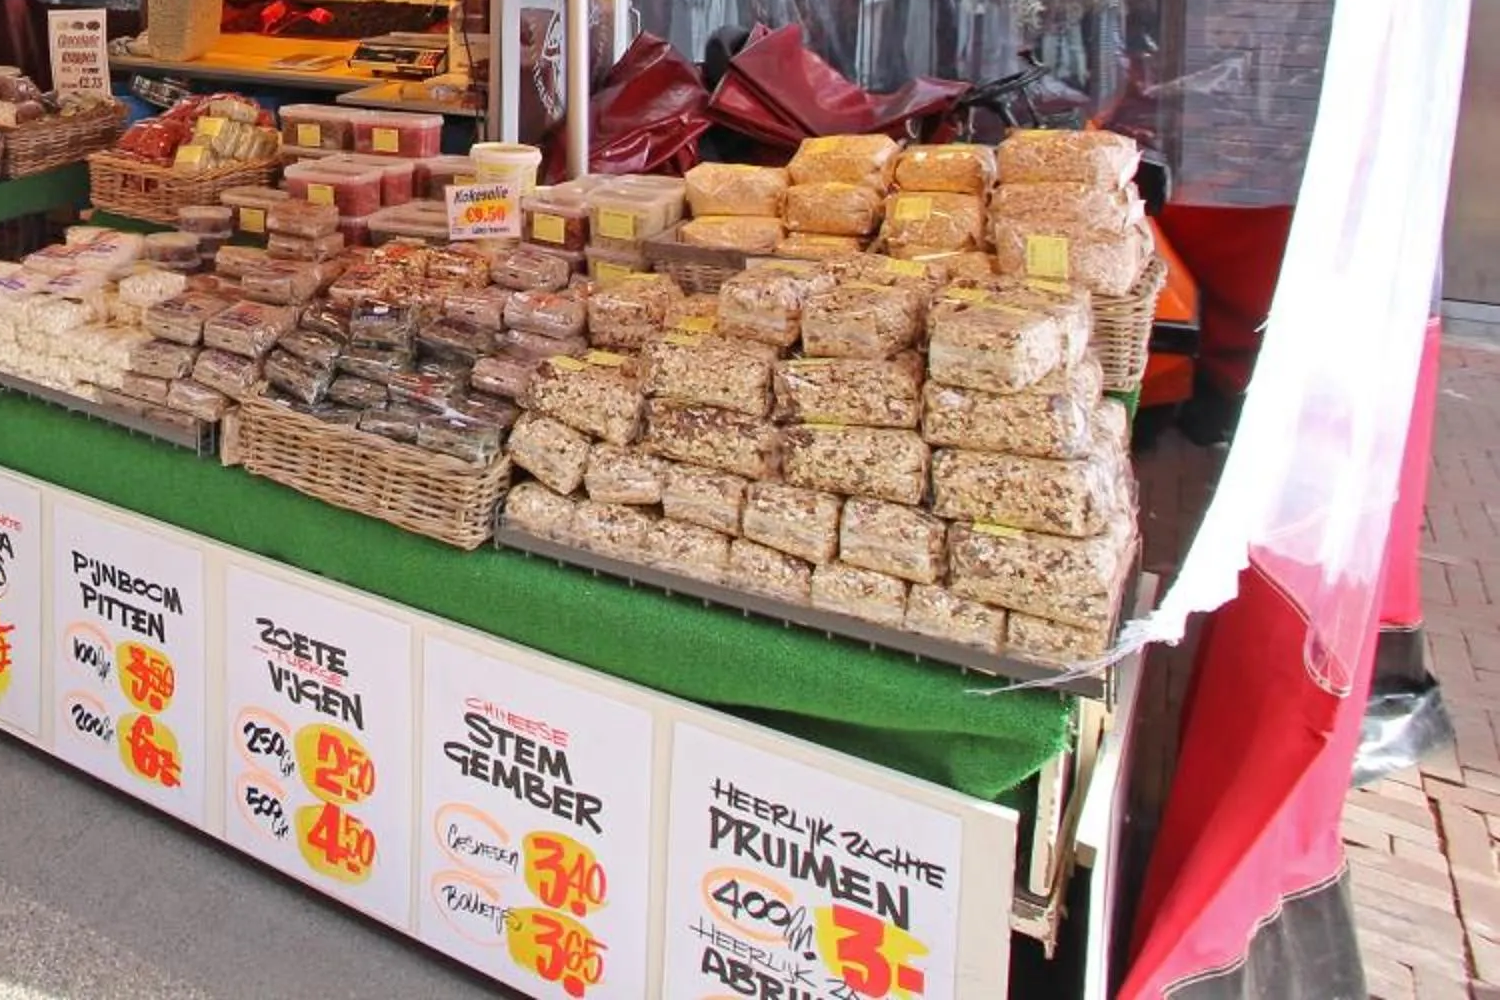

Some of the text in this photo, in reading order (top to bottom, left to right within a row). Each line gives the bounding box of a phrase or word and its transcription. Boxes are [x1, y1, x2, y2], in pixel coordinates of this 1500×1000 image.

[72, 550, 183, 615] PIJNBOOM
[80, 581, 165, 643] PITTEN
[256, 617, 349, 677] ZOETE
[268, 660, 364, 730] VIJGEN
[464, 712, 572, 785] STEM
[443, 741, 602, 834] GEMBER
[709, 805, 908, 930] PRUIMEN
[710, 778, 946, 888] HEERLIJK ZACHTE
